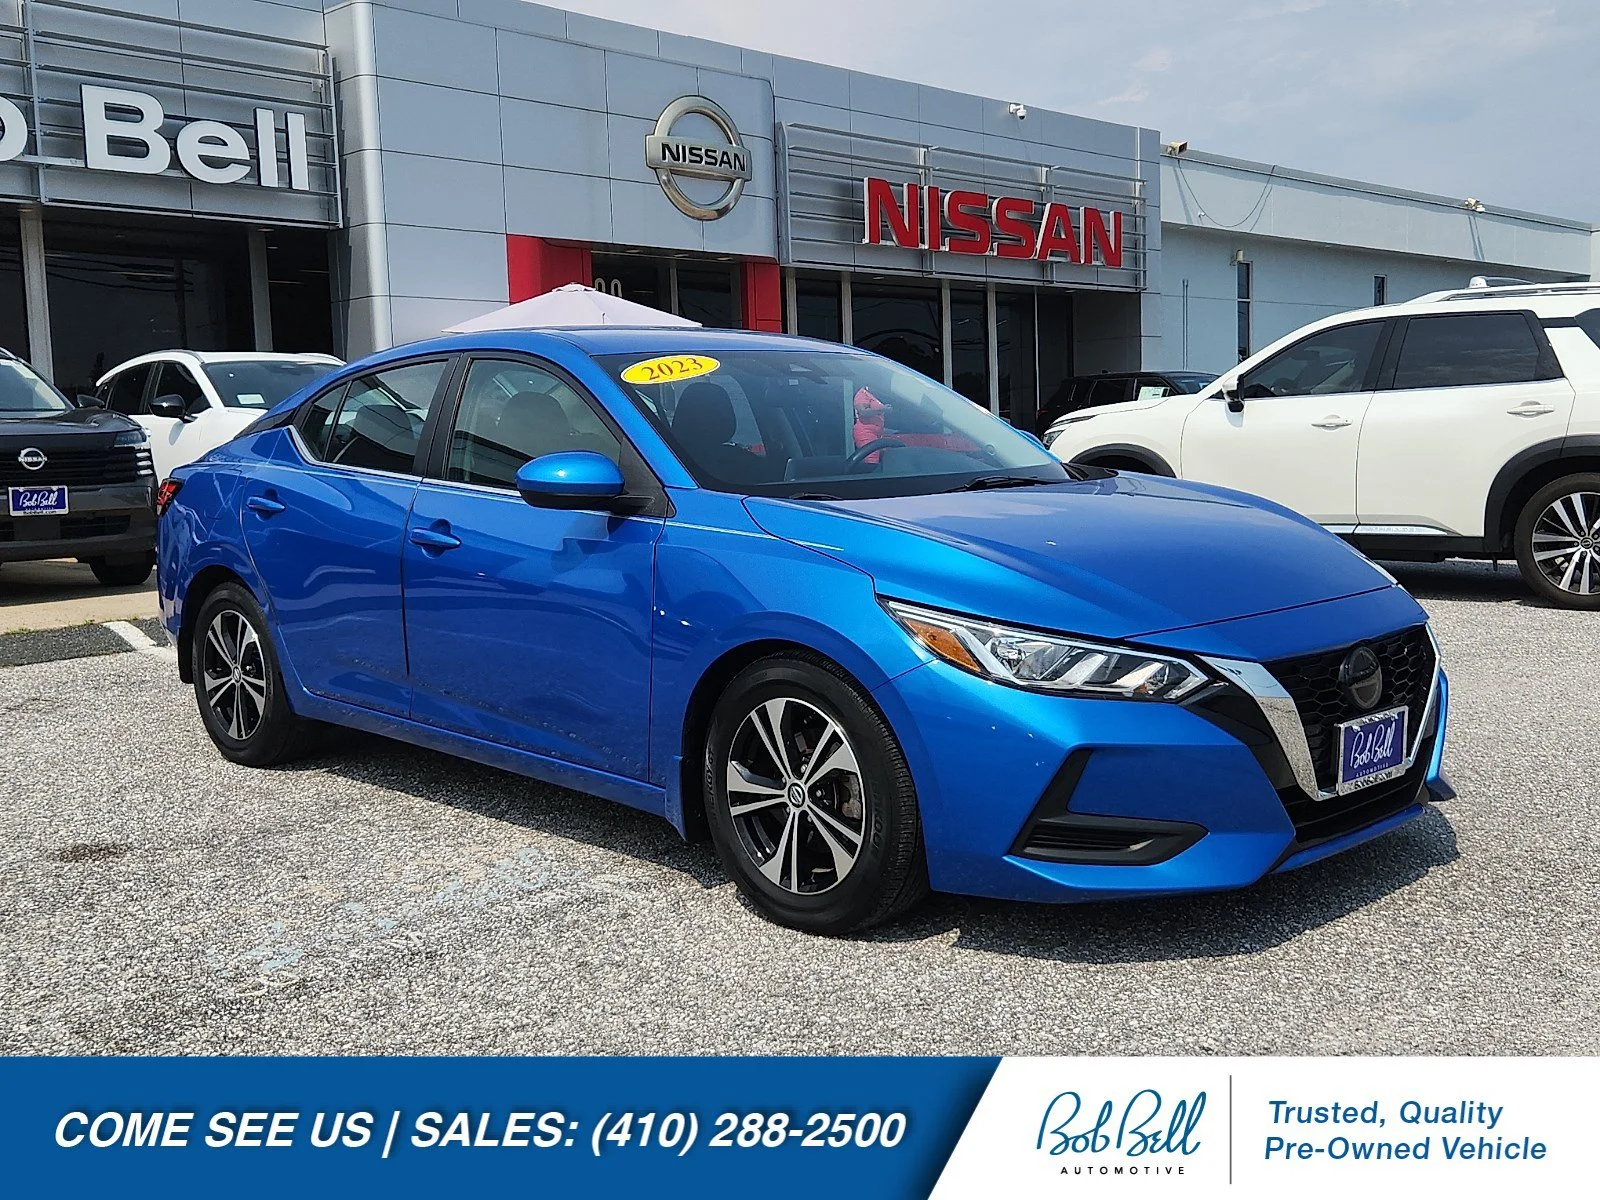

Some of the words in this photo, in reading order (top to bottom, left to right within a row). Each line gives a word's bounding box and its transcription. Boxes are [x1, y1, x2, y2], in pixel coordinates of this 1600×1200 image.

[80, 84, 309, 190] Bell
[661, 142, 746, 172] NISSAN
[864, 177, 1123, 268] NISSAN
[641, 357, 703, 381] 2023
[19, 491, 38, 508] Bob
[37, 490, 59, 507] Bell
[1349, 731, 1373, 769] Bob
[1371, 721, 1396, 762] Bell
